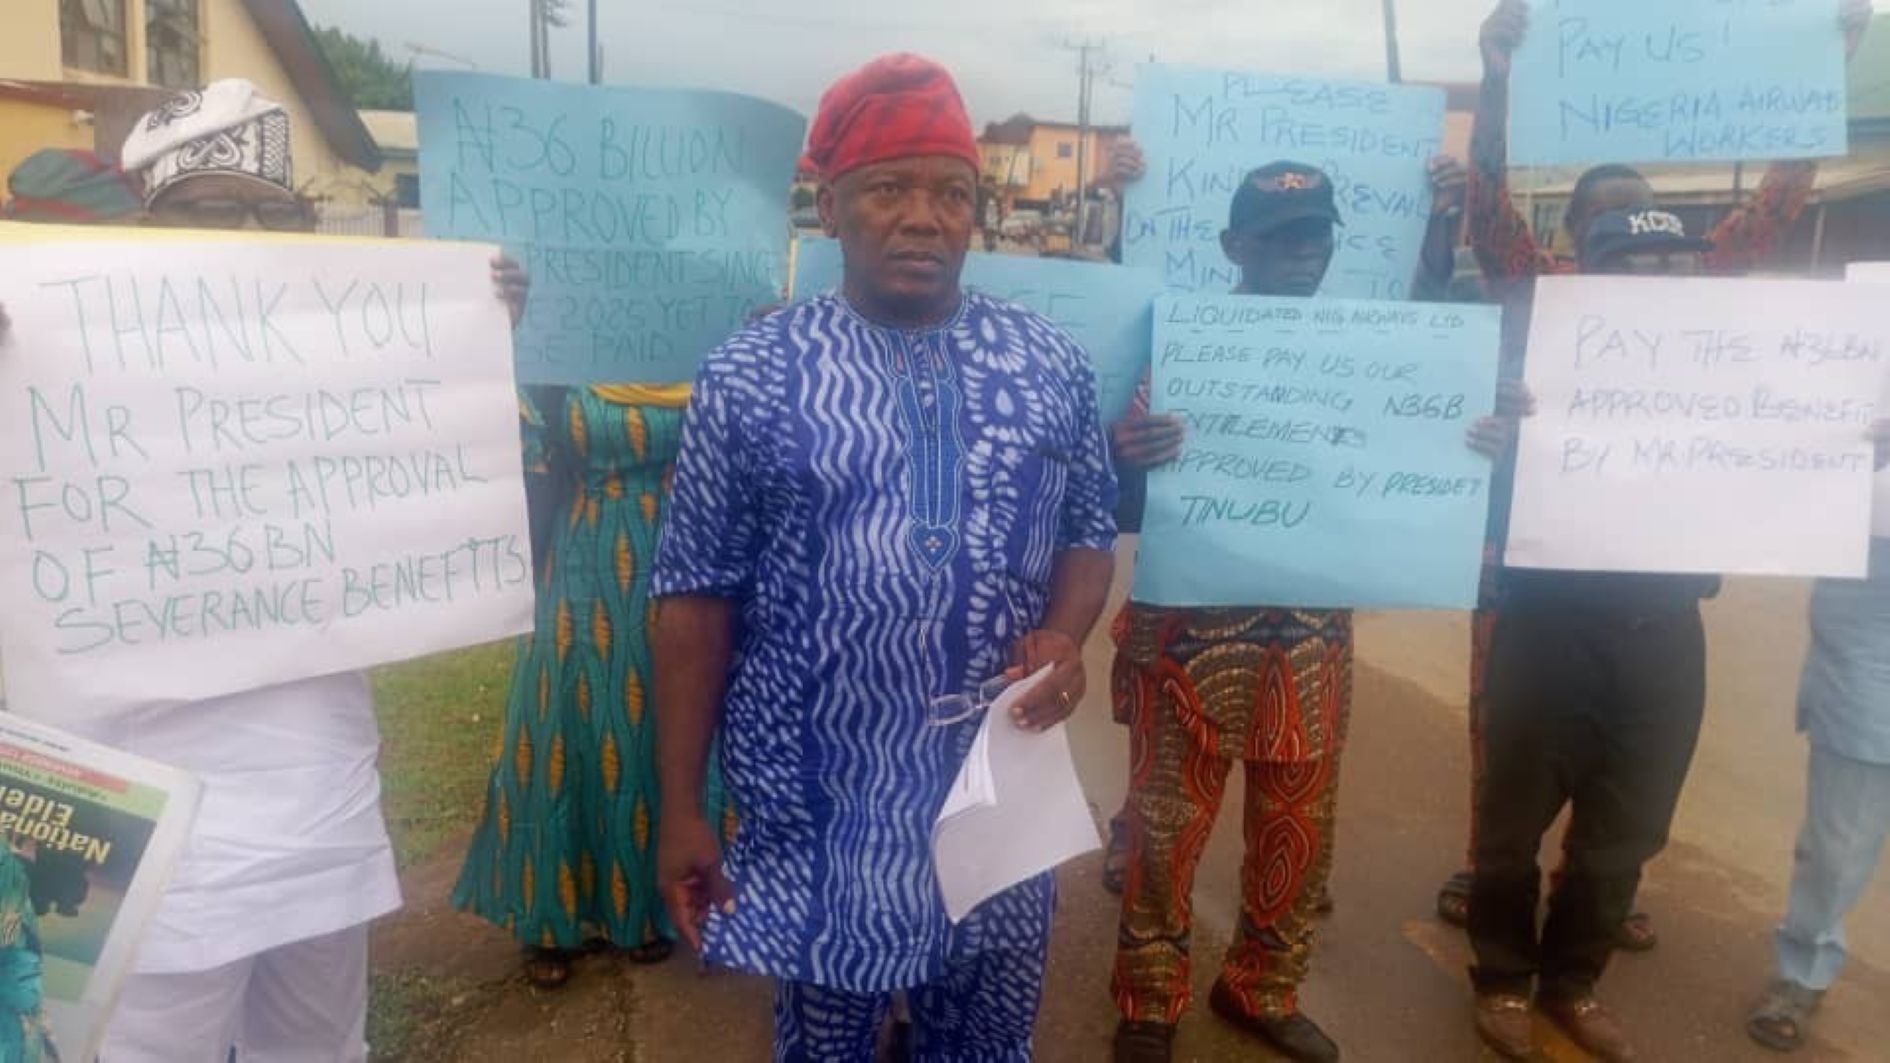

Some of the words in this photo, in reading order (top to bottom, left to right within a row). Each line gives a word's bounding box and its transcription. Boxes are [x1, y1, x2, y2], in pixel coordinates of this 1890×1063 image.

[1558, 17, 1622, 79] PAY
[1223, 73, 1388, 114] PLEASE
[1558, 88, 1721, 142] NIGERIA
[600, 116, 744, 182] BILLION
[1172, 94, 1239, 148] MR
[1261, 105, 1434, 159] PRESIDENT
[1666, 124, 1828, 157] WORKERS
[447, 171, 682, 246] APPROVED
[693, 186, 735, 238] BY
[1155, 206, 1220, 242] THE
[525, 243, 694, 289] PRESIDENT
[38, 274, 305, 375] THANK
[312, 277, 433, 358] YOU
[560, 295, 646, 331] 2025
[655, 295, 713, 331] YET
[1165, 302, 1303, 326] LIQUIDATED
[590, 330, 674, 365] PAID
[1161, 343, 1250, 369] PLEASE
[1262, 349, 1306, 372] PAY
[1320, 354, 1355, 377] US
[1365, 360, 1420, 383] OUR
[1575, 314, 1665, 370] PAY
[1682, 328, 1760, 369] THE
[175, 378, 441, 454] PRESIDENT
[1167, 376, 1354, 412] OUTSTANDING
[1567, 388, 1742, 421] APPROVED
[1562, 437, 1610, 473] BY
[1687, 437, 1866, 473] PRESIDENT
[11, 475, 154, 541] FOR
[177, 463, 268, 519] THE
[286, 446, 488, 519] APPROVAL
[1334, 467, 1373, 499] BY
[32, 546, 115, 607] OF
[54, 577, 325, 655] SEVERANCE
